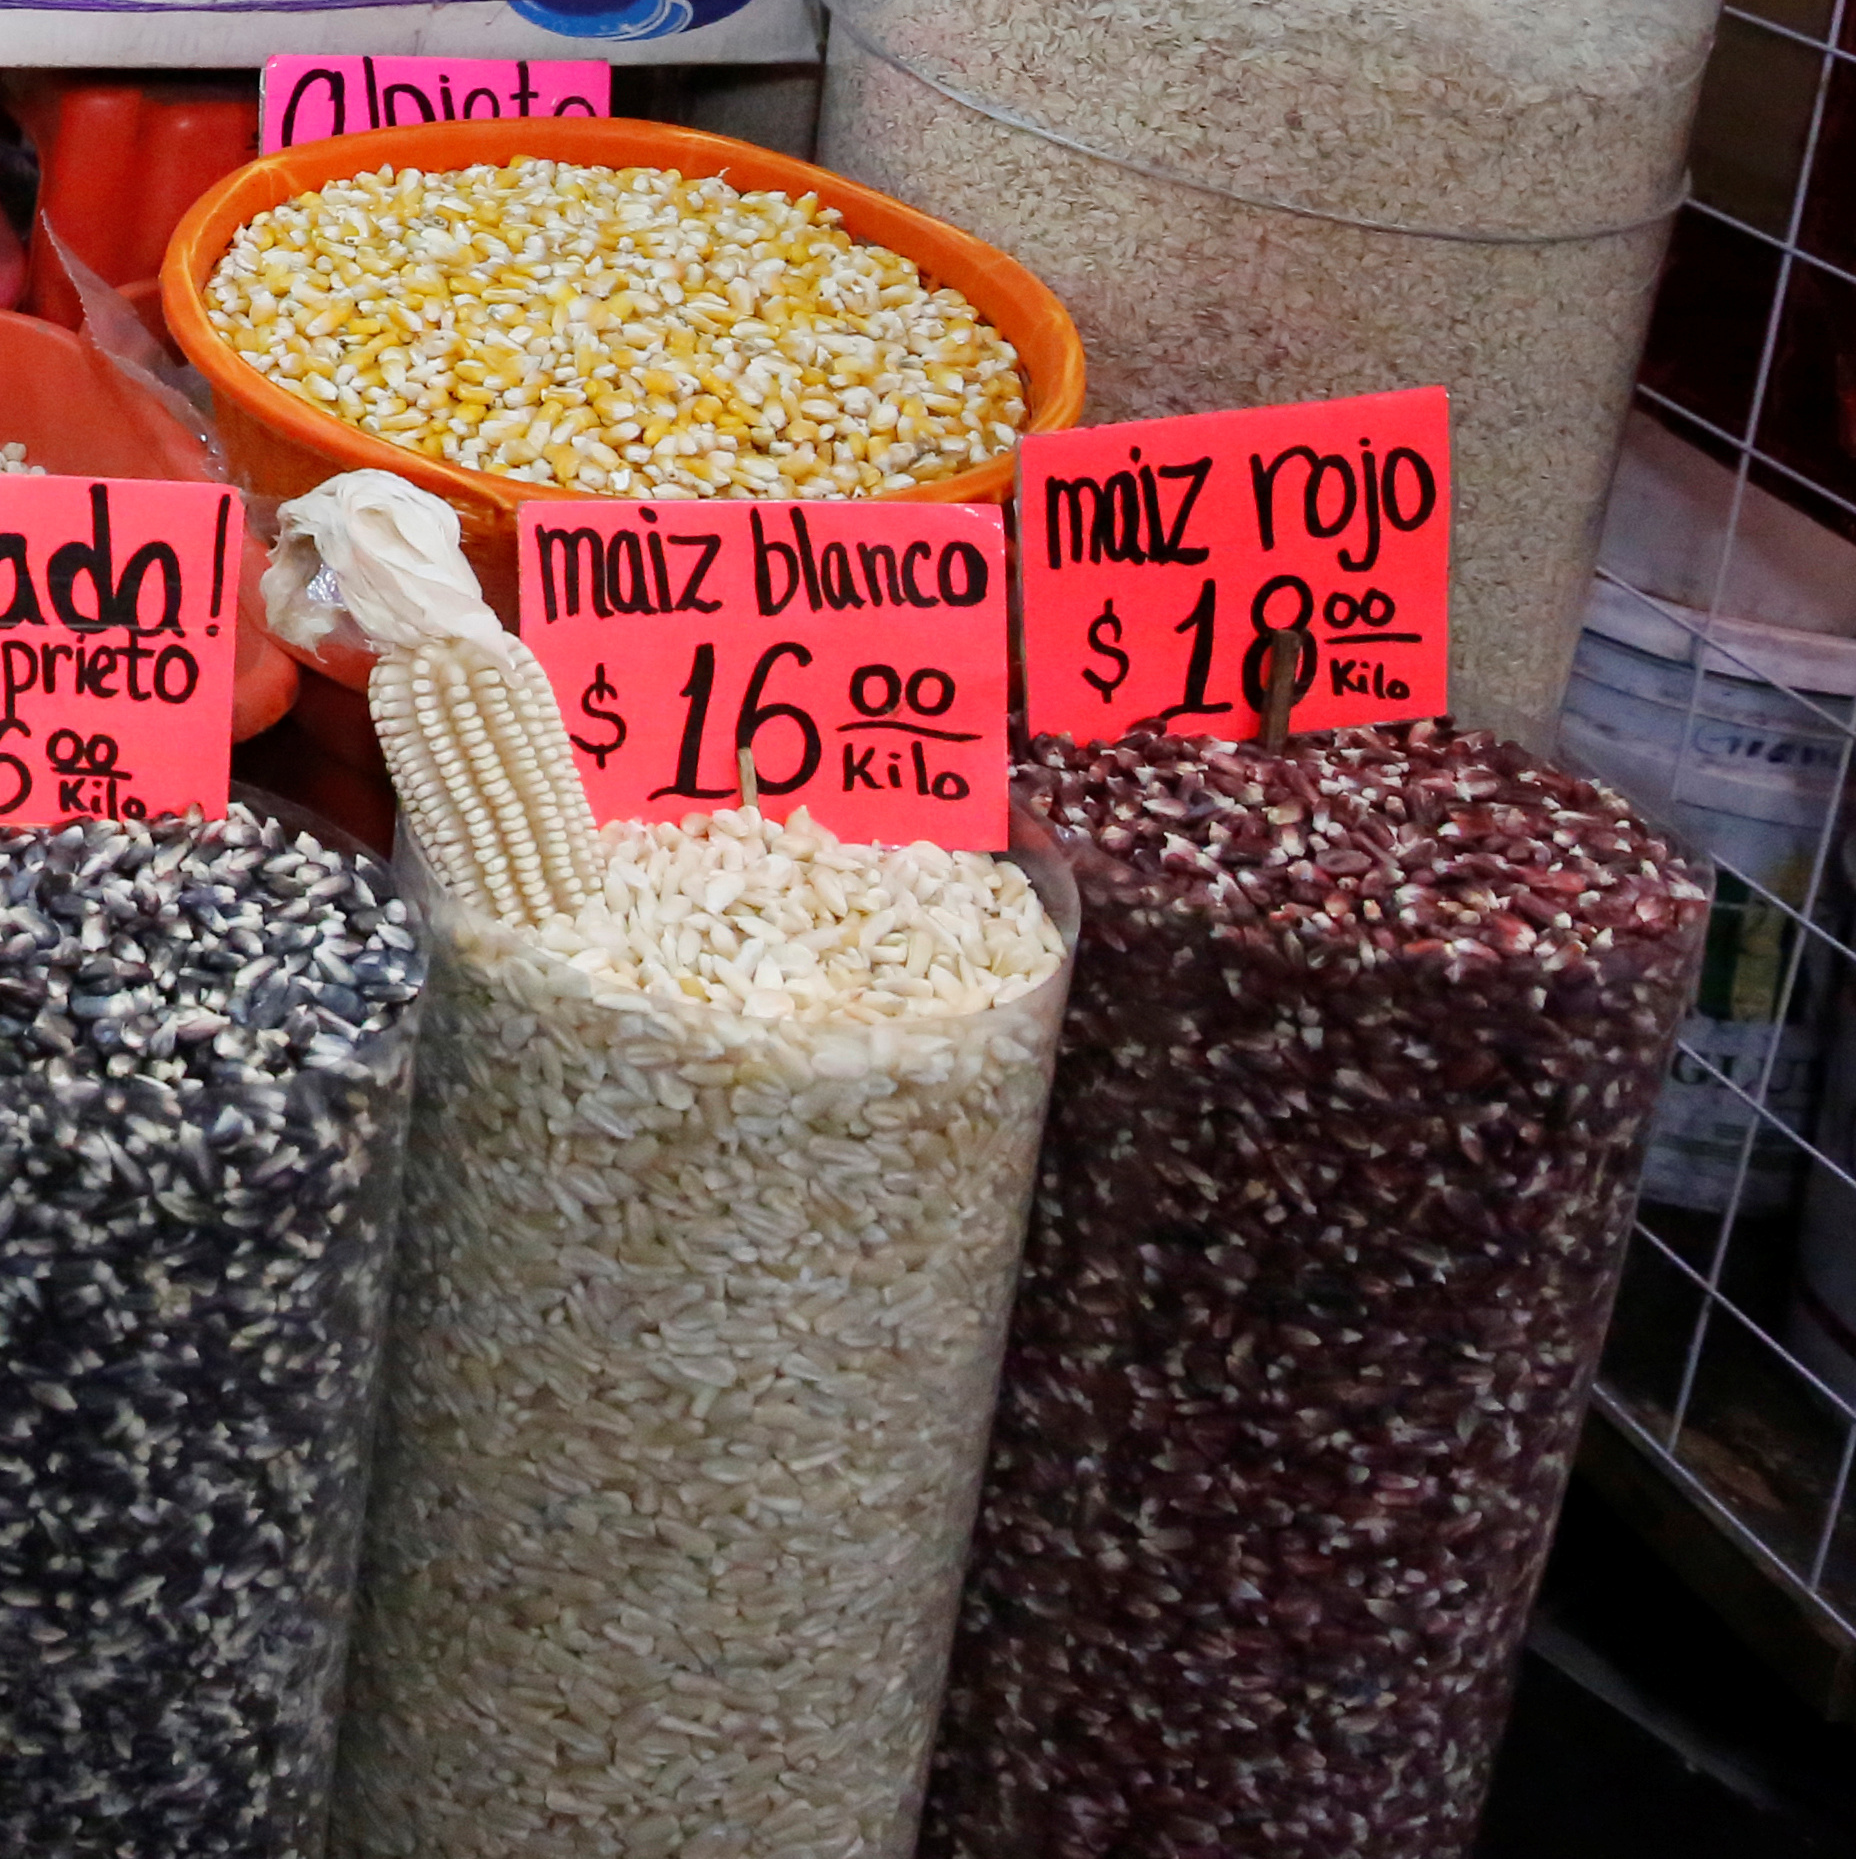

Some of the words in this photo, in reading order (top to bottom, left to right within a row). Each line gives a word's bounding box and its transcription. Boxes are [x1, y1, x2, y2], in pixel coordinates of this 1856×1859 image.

[1249, 436, 1438, 573] rojo
[749, 506, 990, 618] blanco
[3, 634, 200, 719] prieto
[1157, 574, 1318, 719] 18
[1322, 588, 1396, 627] 00
[1330, 657, 1412, 700] Kilo
[45, 727, 119, 774] 00
[647, 640, 822, 801] 16
[848, 664, 958, 717] 00
[841, 741, 972, 802] Kilo
